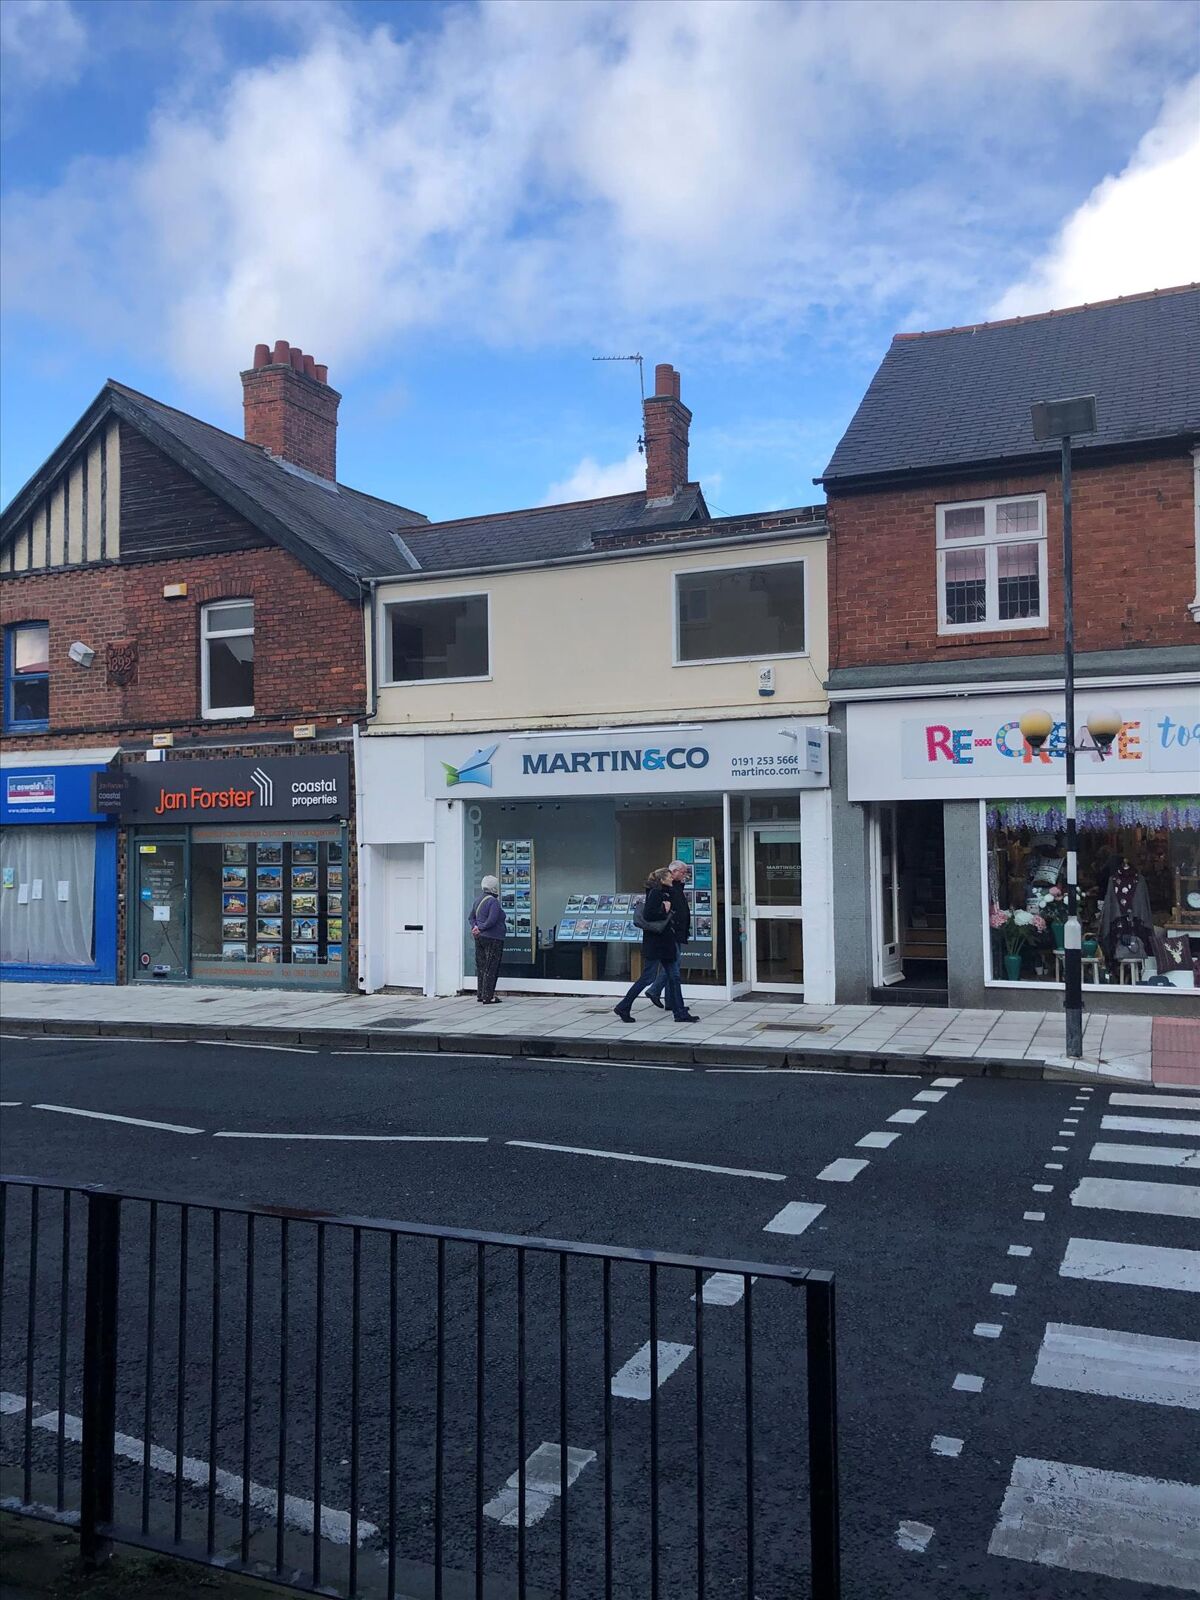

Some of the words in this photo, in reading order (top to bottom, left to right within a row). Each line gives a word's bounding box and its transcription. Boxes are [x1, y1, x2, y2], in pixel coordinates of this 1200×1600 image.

[925, 721, 1143, 764] RE-CEAE
[522, 747, 709, 774] MARTIN&CO
[731, 757, 754, 766] 0191
[757, 756, 774, 765] 253
[731, 767, 800, 776] martinco.com
[291, 779, 337, 793] coastal
[155, 789, 187, 814] Jan
[191, 788, 255, 809] Forster
[292, 793, 338, 807] properties
